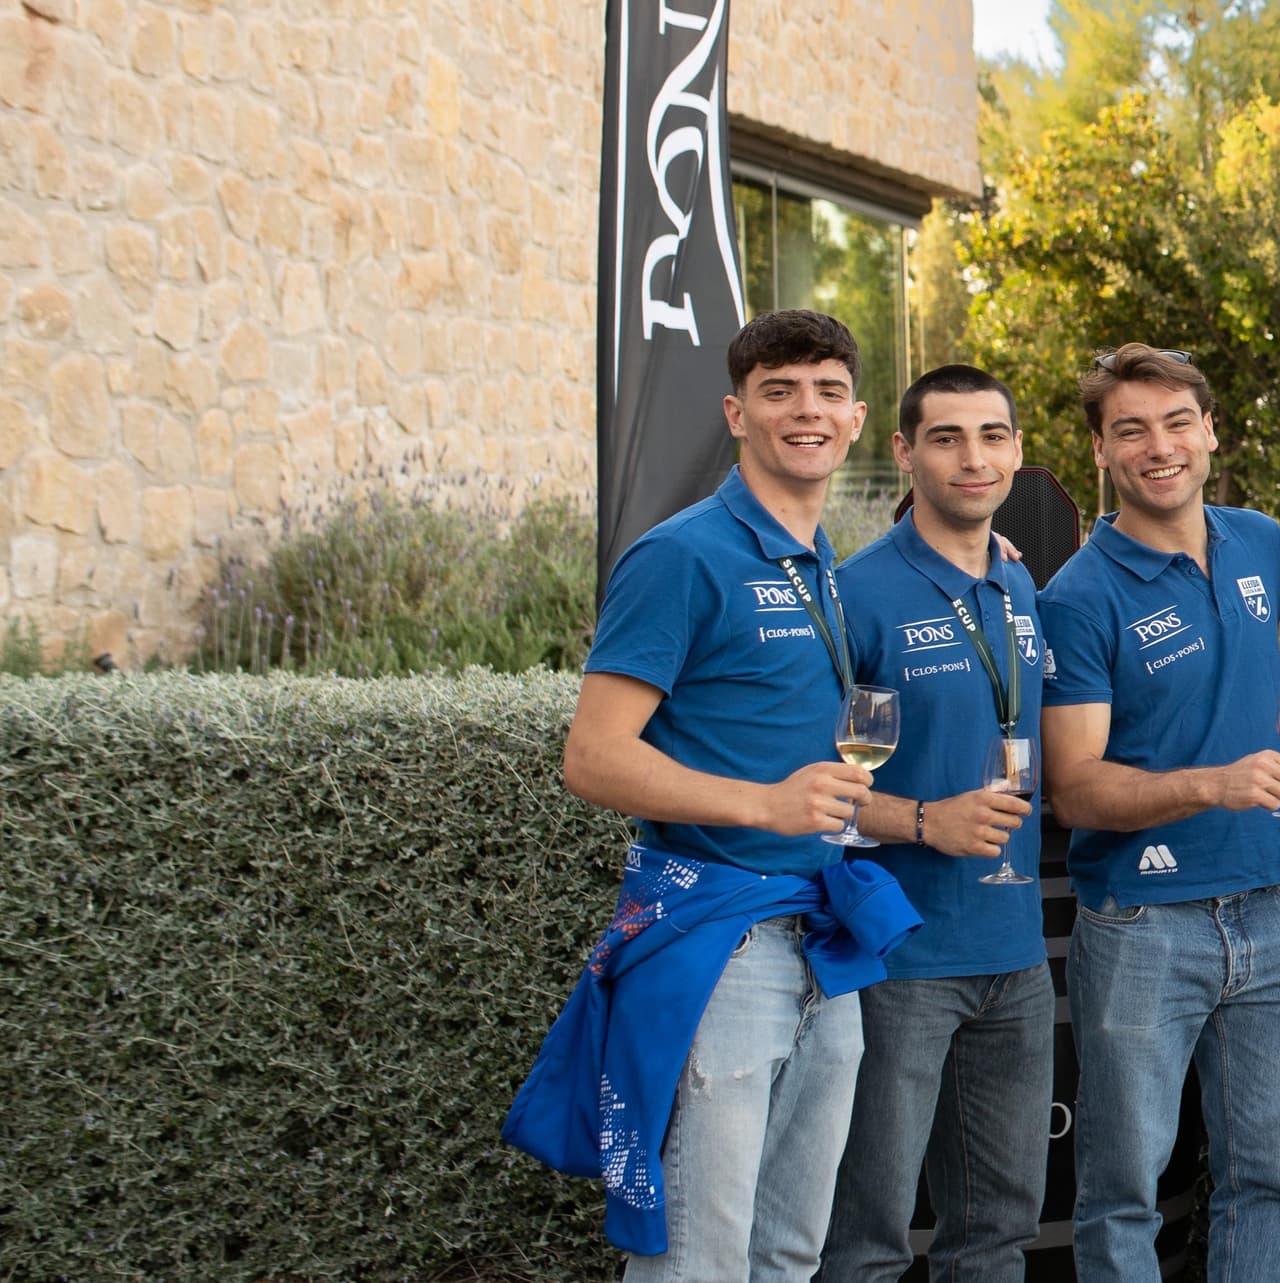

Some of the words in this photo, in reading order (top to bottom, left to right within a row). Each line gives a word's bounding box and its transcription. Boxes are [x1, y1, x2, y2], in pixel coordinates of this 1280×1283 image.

[642, 0, 724, 347] PON
[752, 586, 797, 606] PONS
[903, 623, 955, 646] PONS
[1134, 612, 1183, 643] PONS
[1153, 653, 1177, 670] CLOS
[1177, 641, 1200, 659] PONS
[911, 665, 939, 678] CLOS
[942, 661, 966, 673] PONS
